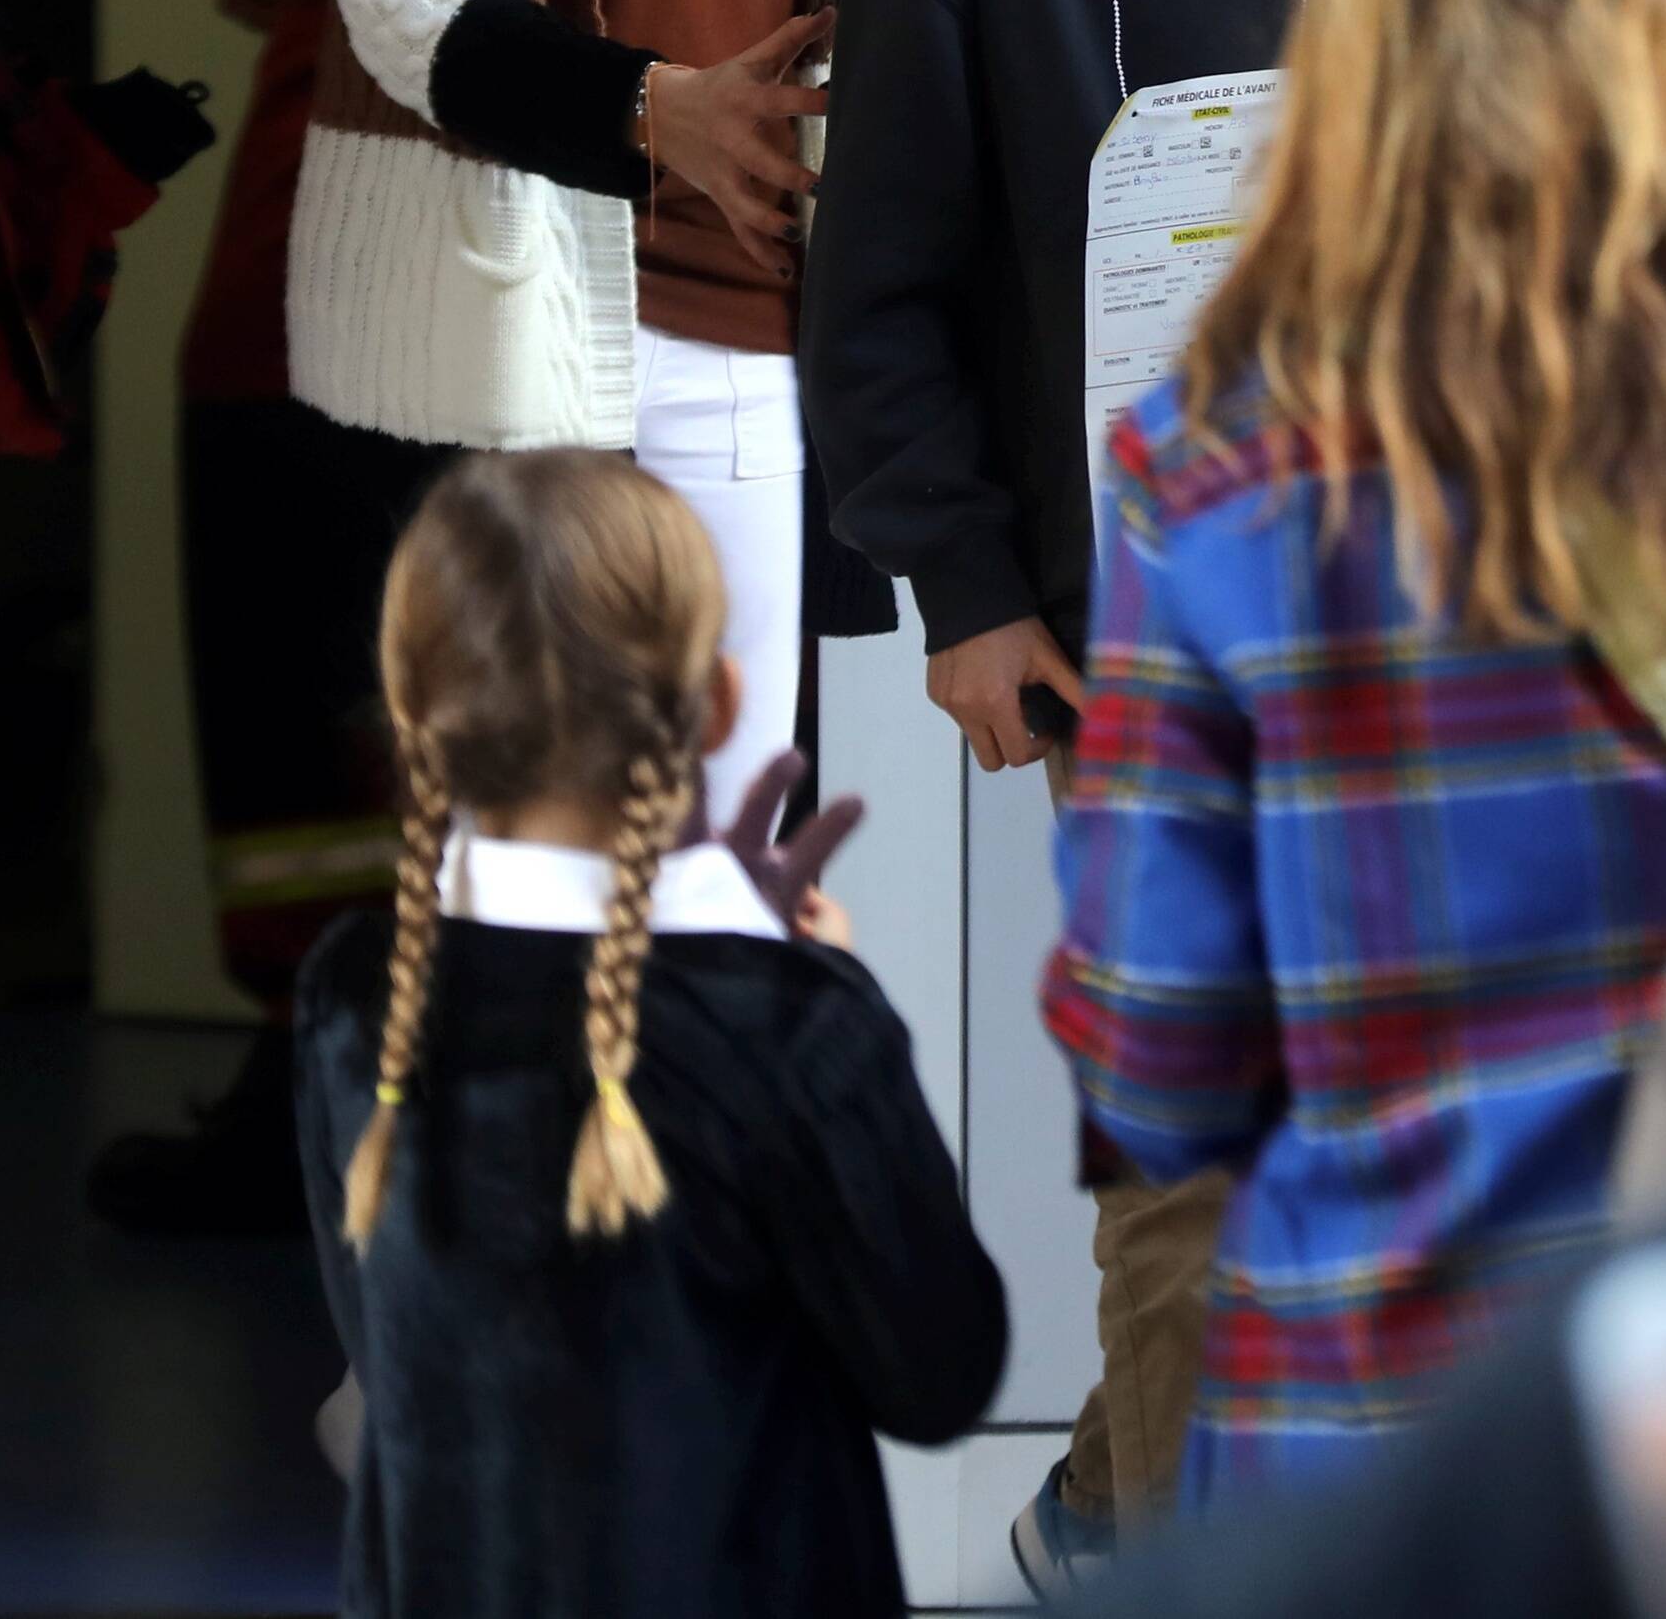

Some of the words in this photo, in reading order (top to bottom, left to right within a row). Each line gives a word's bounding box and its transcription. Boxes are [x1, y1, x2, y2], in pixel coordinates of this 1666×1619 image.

[1152, 94, 1174, 108] FICHE
[1176, 88, 1220, 103] MÉDICALE
[1222, 87, 1234, 98] DE
[1237, 82, 1277, 96] L'AVANT
[1172, 229, 1214, 243] PATHOLOGIE
